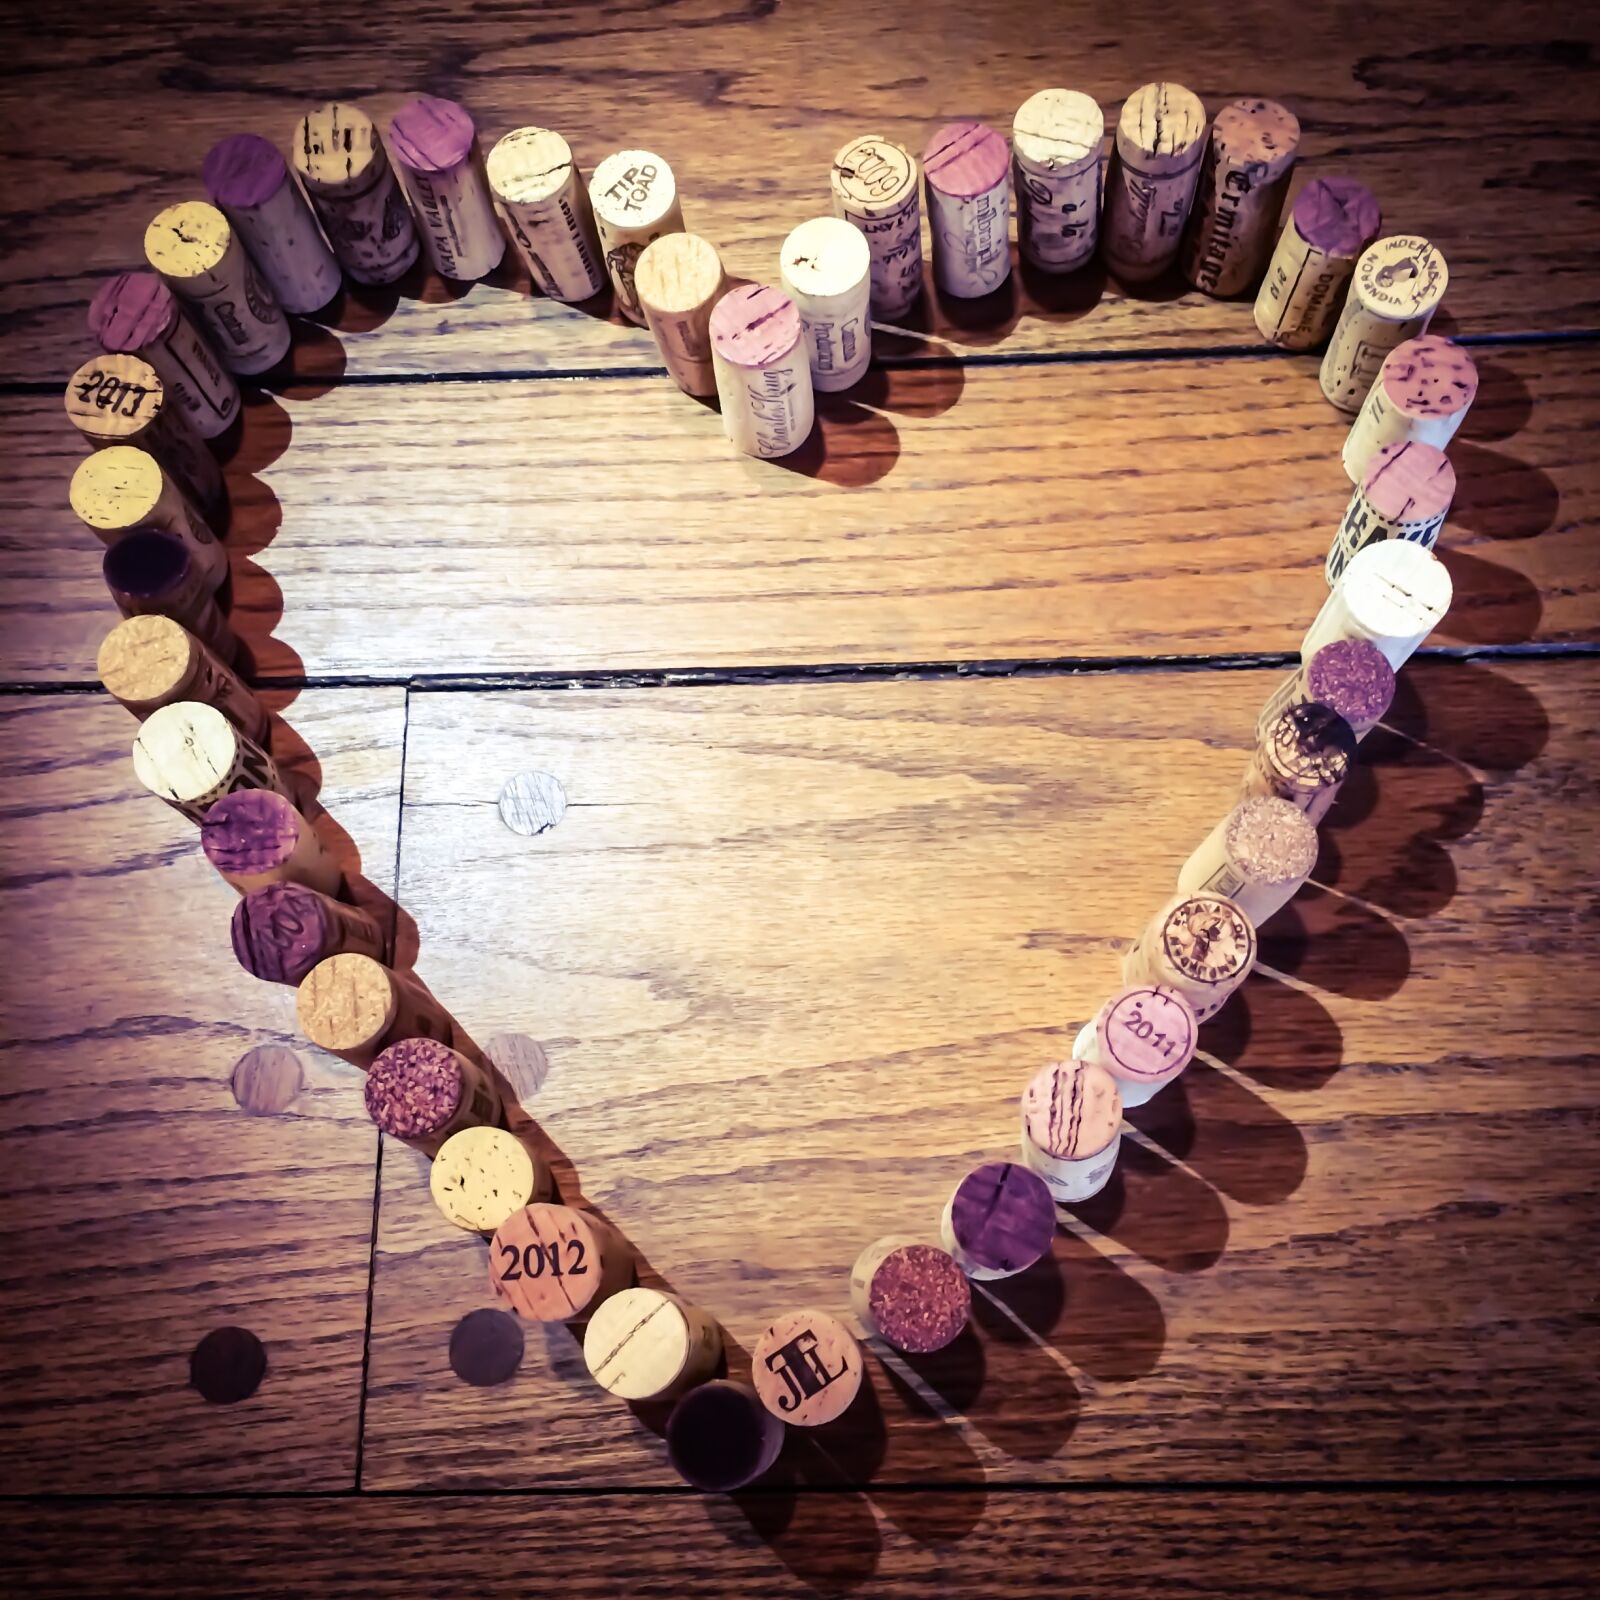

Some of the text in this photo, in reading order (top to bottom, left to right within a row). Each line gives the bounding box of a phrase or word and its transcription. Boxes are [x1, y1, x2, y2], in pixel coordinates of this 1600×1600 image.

[604, 166, 640, 201] TIP
[624, 164, 658, 212] TOAD
[434, 235, 459, 278] NAPA
[1125, 1010, 1176, 1057] 2011
[501, 1239, 588, 1281] 2012
